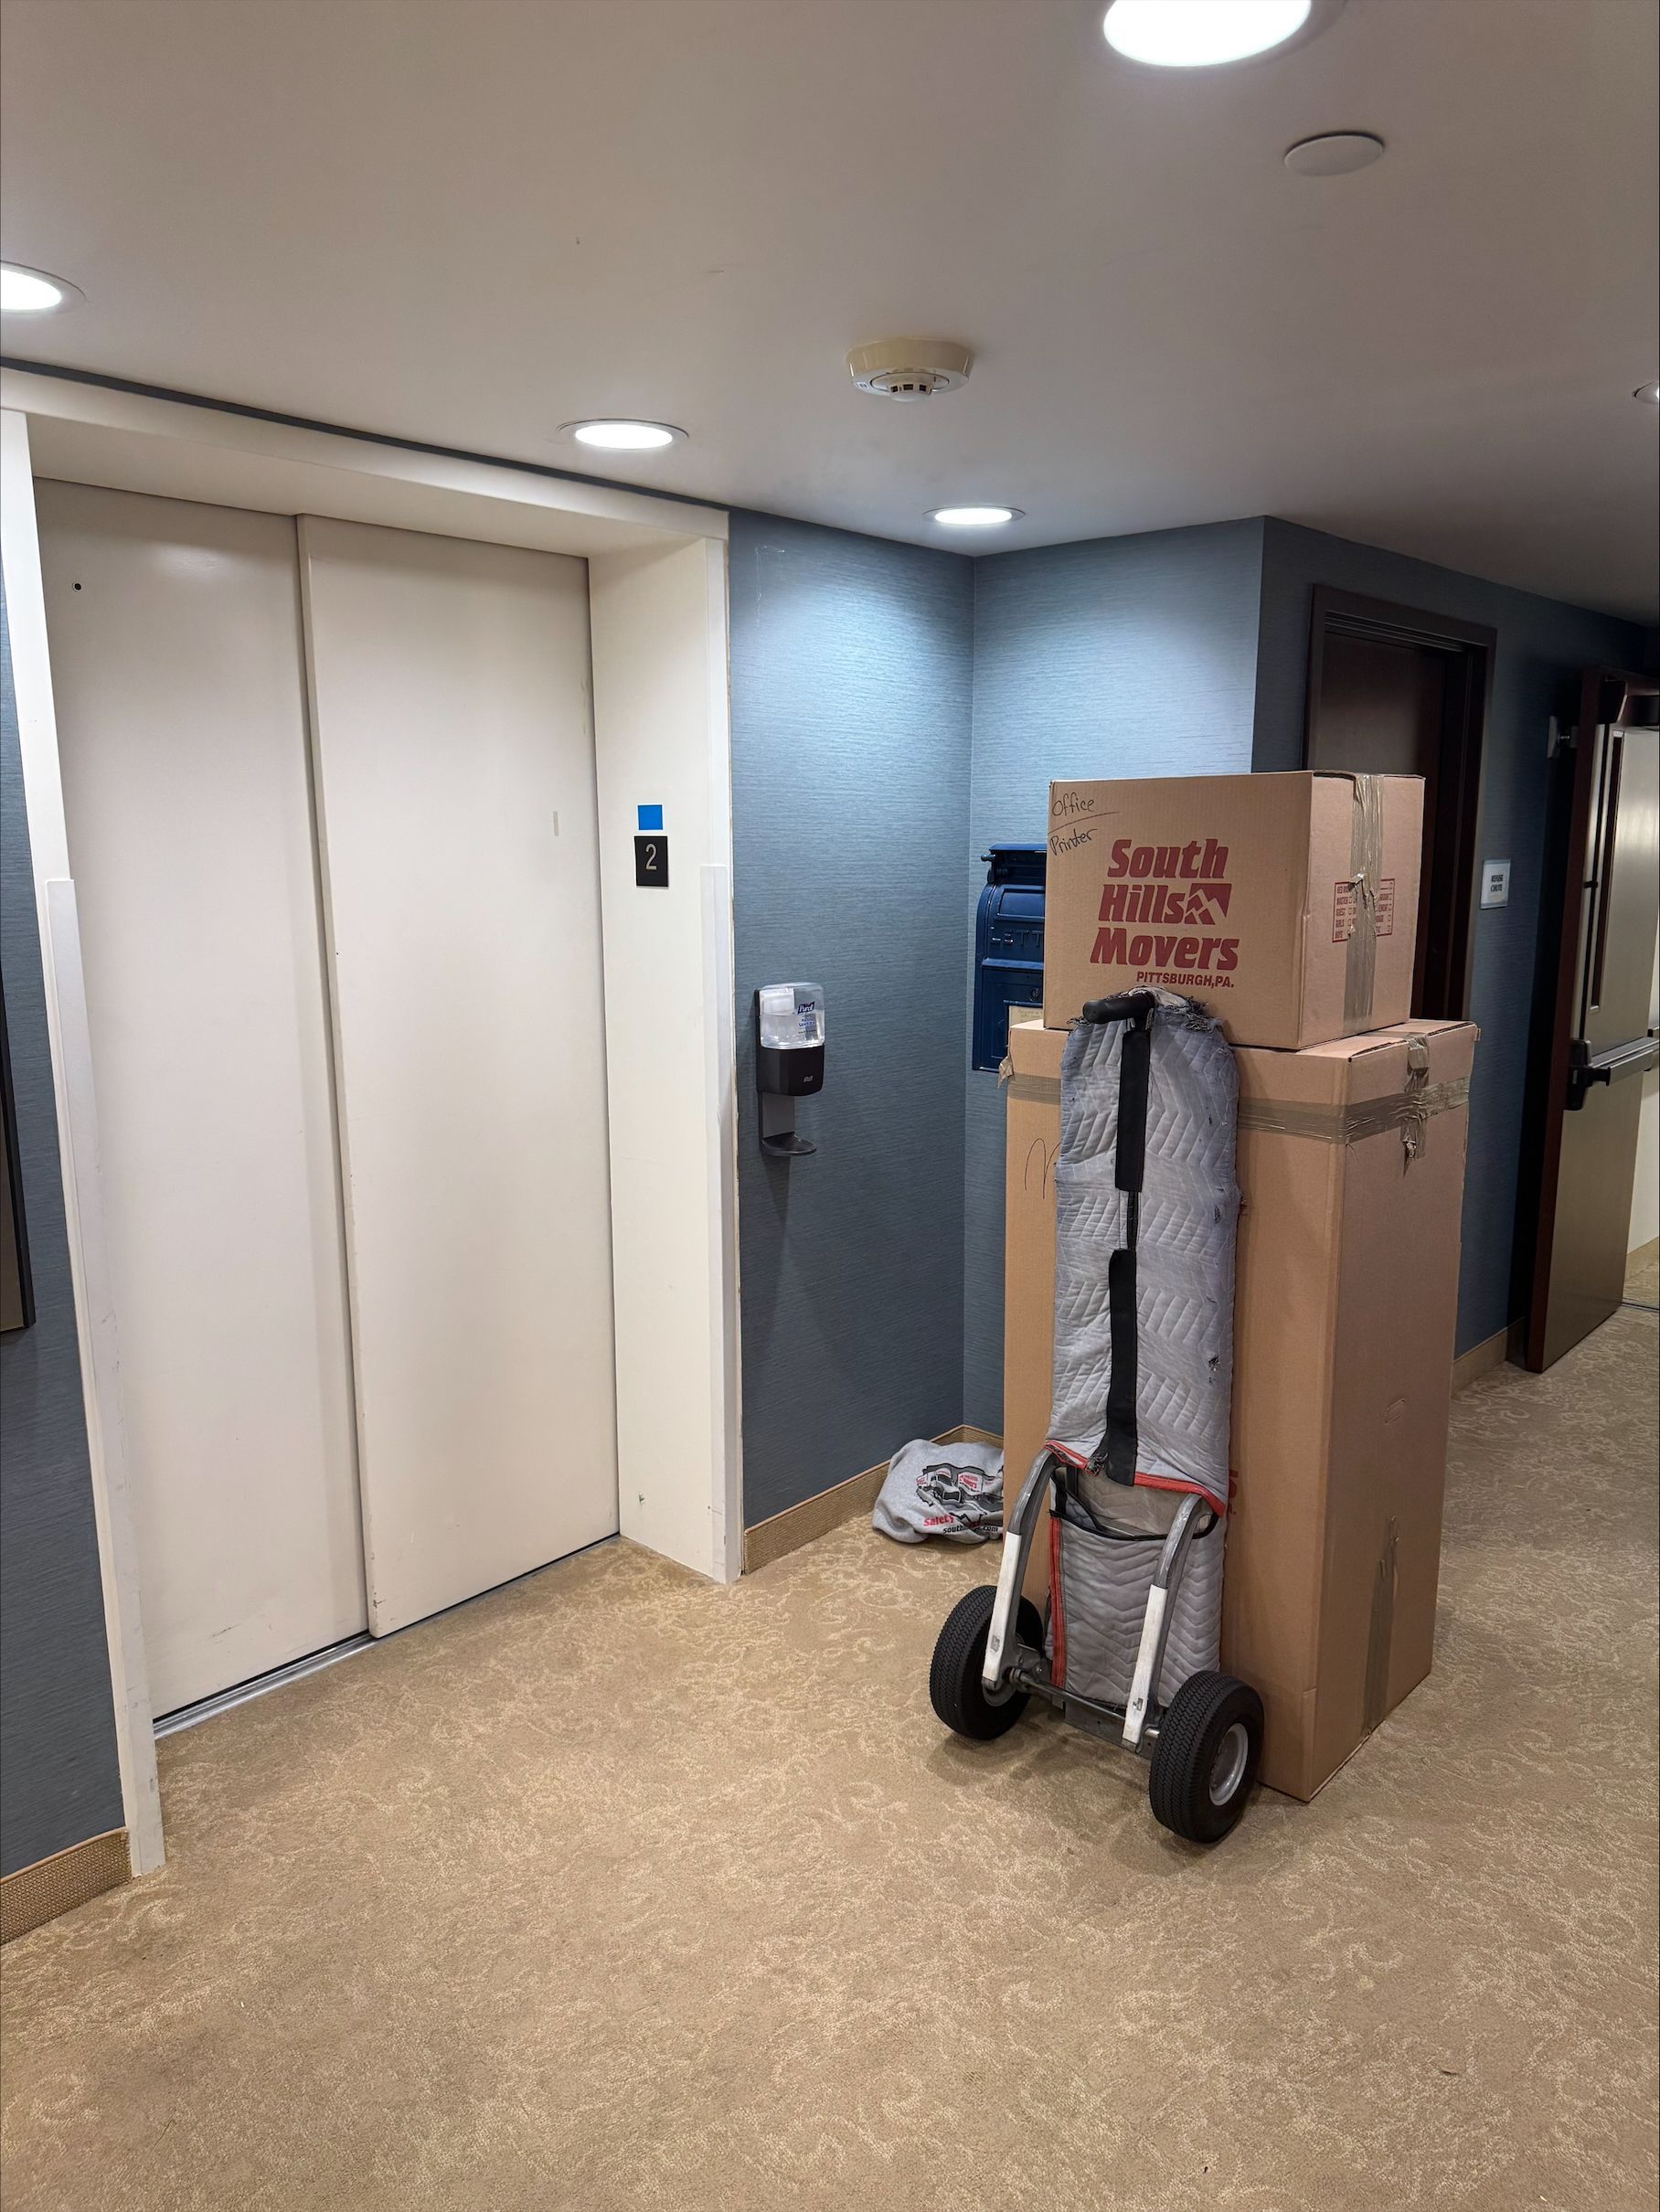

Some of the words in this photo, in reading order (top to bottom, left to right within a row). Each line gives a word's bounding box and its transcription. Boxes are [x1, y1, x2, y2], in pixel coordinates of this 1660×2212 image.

[1052, 792, 1094, 816] Office
[645, 843, 657, 870] 2
[1049, 828, 1098, 856] Printer
[1107, 838, 1229, 878] South
[1098, 884, 1186, 923] Hills
[1090, 927, 1240, 971] Movers
